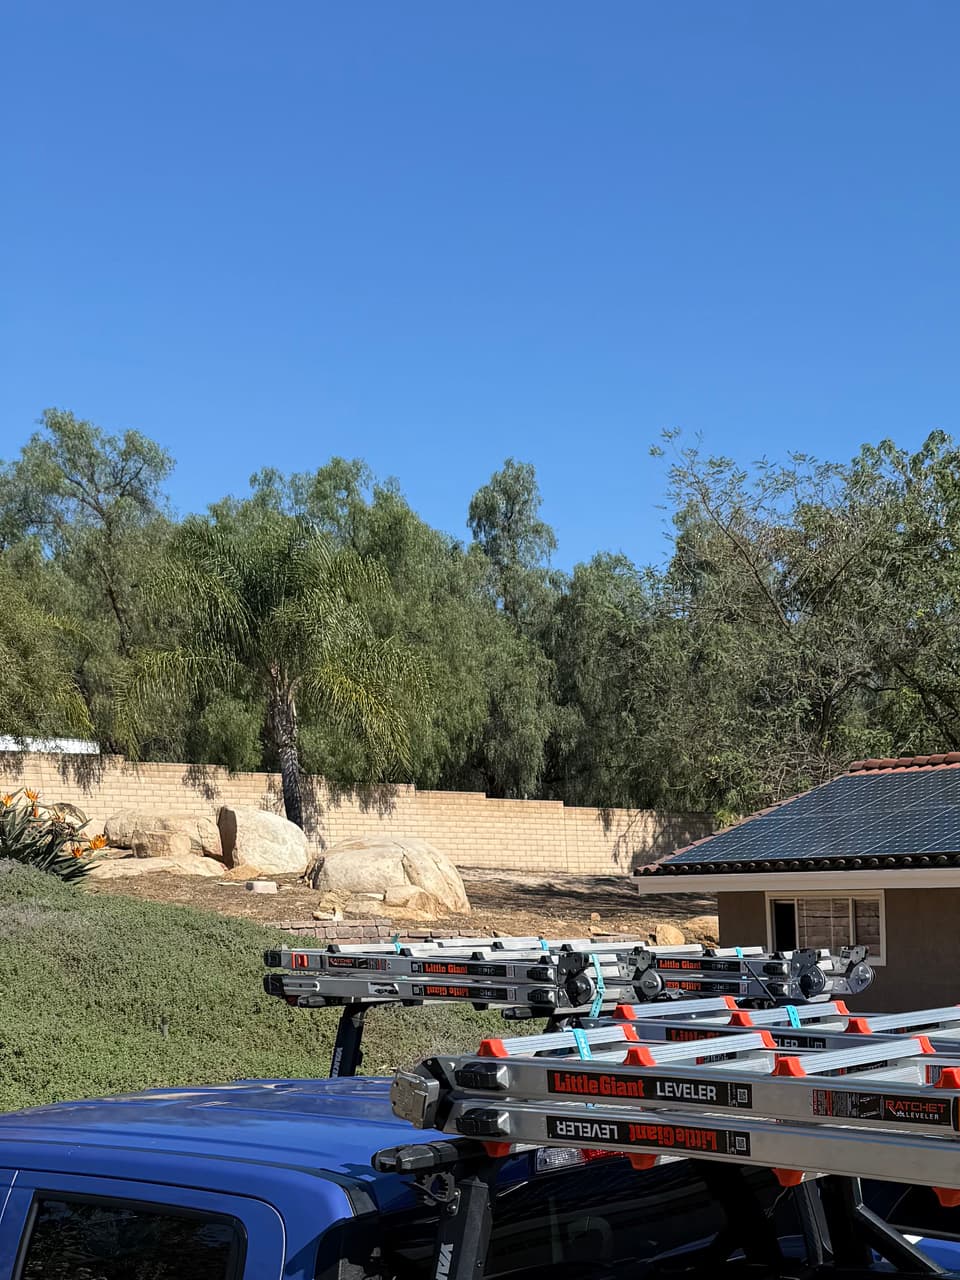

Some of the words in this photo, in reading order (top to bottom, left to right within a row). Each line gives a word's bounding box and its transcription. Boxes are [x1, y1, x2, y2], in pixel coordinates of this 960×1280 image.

[425, 963, 446, 973] Little
[447, 964, 468, 974] Giant
[656, 1080, 717, 1101] LEVELER
[885, 1100, 946, 1114] RATCHET
[556, 1120, 618, 1140] LEVELER
